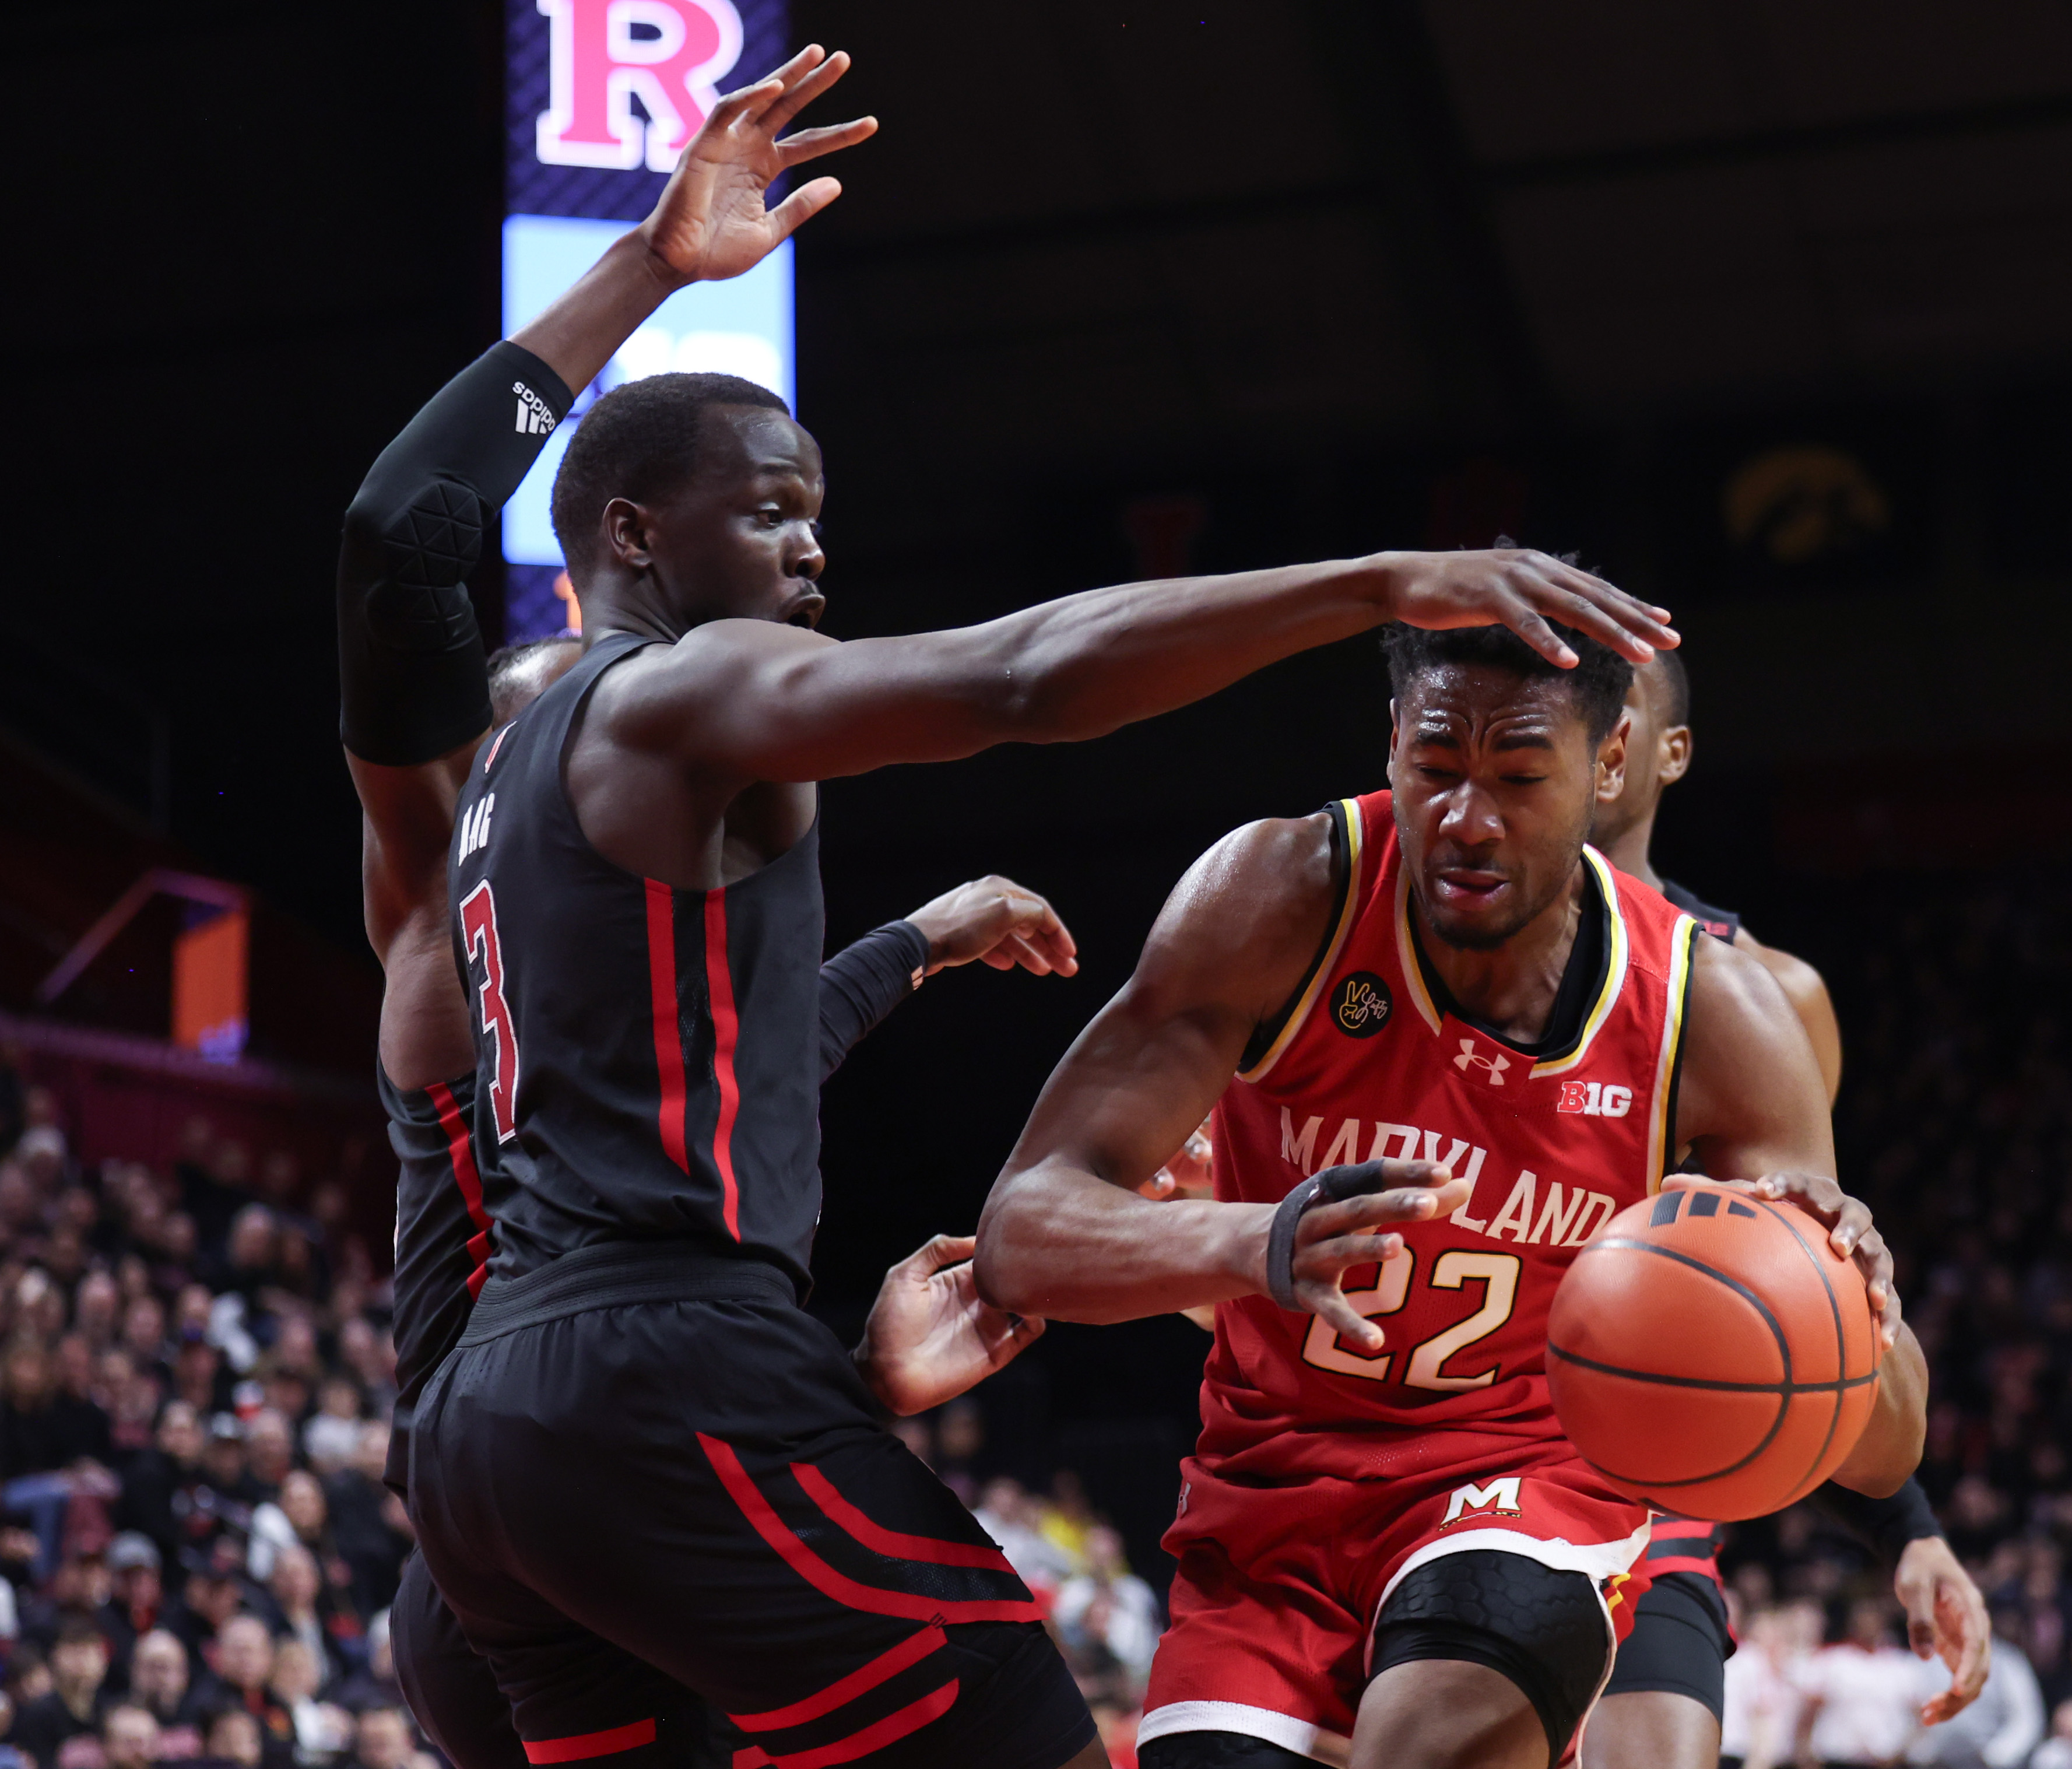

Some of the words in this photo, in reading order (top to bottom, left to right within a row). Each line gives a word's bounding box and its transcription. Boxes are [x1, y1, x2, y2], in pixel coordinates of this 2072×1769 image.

[536, 0, 744, 173] R
[512, 381, 556, 431] adidas
[459, 878, 519, 1146] 3
[1301, 1244, 1523, 1394] 22
[1439, 1477, 1522, 1526] M
